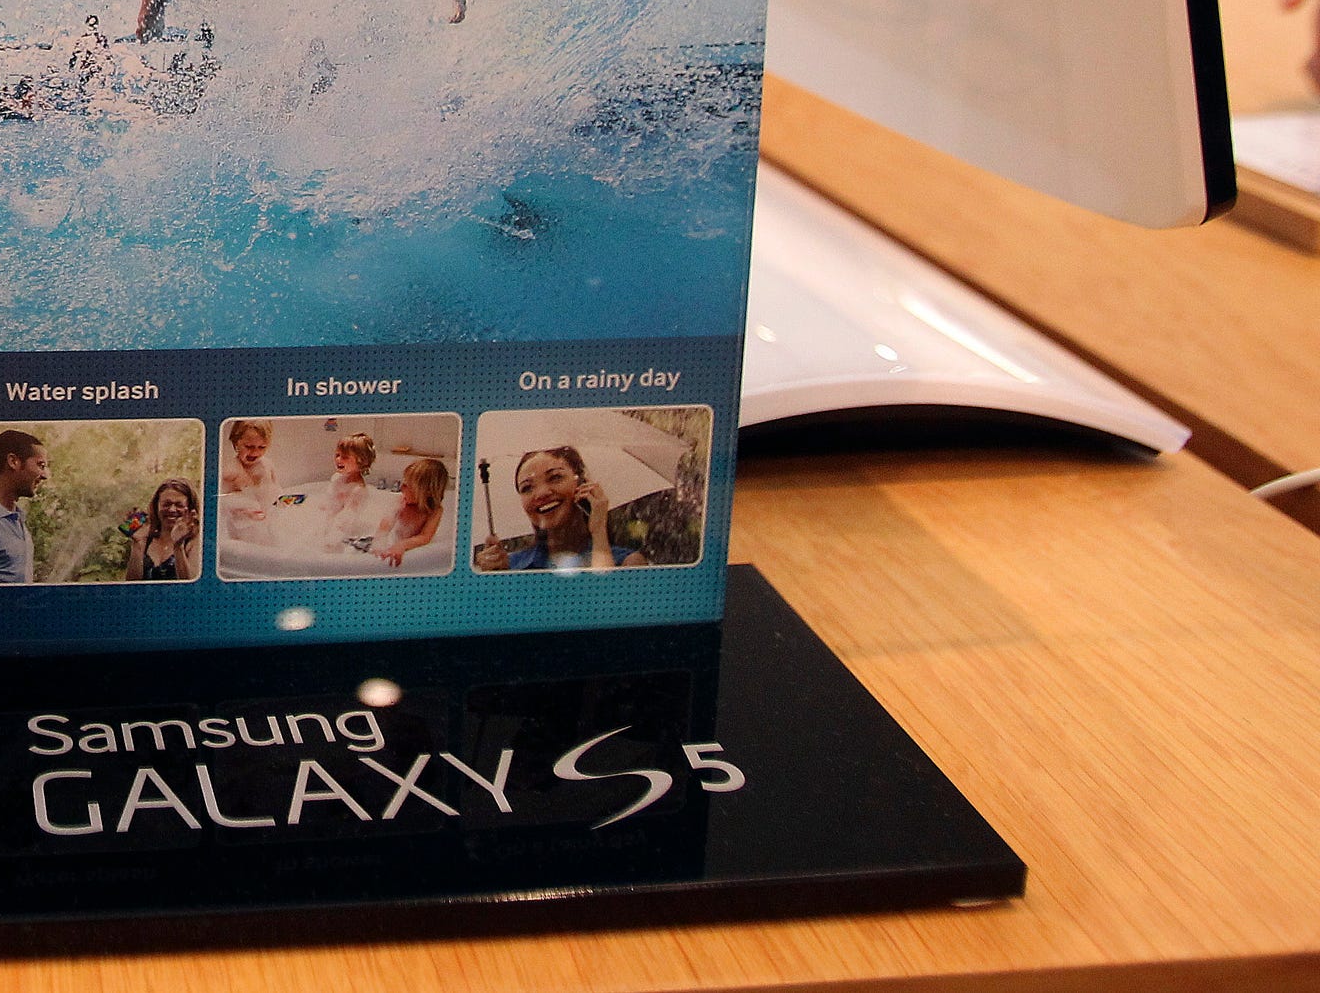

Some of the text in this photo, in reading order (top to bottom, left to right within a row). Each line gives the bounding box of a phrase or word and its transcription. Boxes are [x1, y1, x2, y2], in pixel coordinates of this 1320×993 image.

[6, 381, 159, 405] Water splash
[286, 376, 402, 397] In shower
[518, 367, 681, 393] On a rainy day
[27, 710, 386, 756] Samsung
[31, 748, 514, 835] GALAXY
